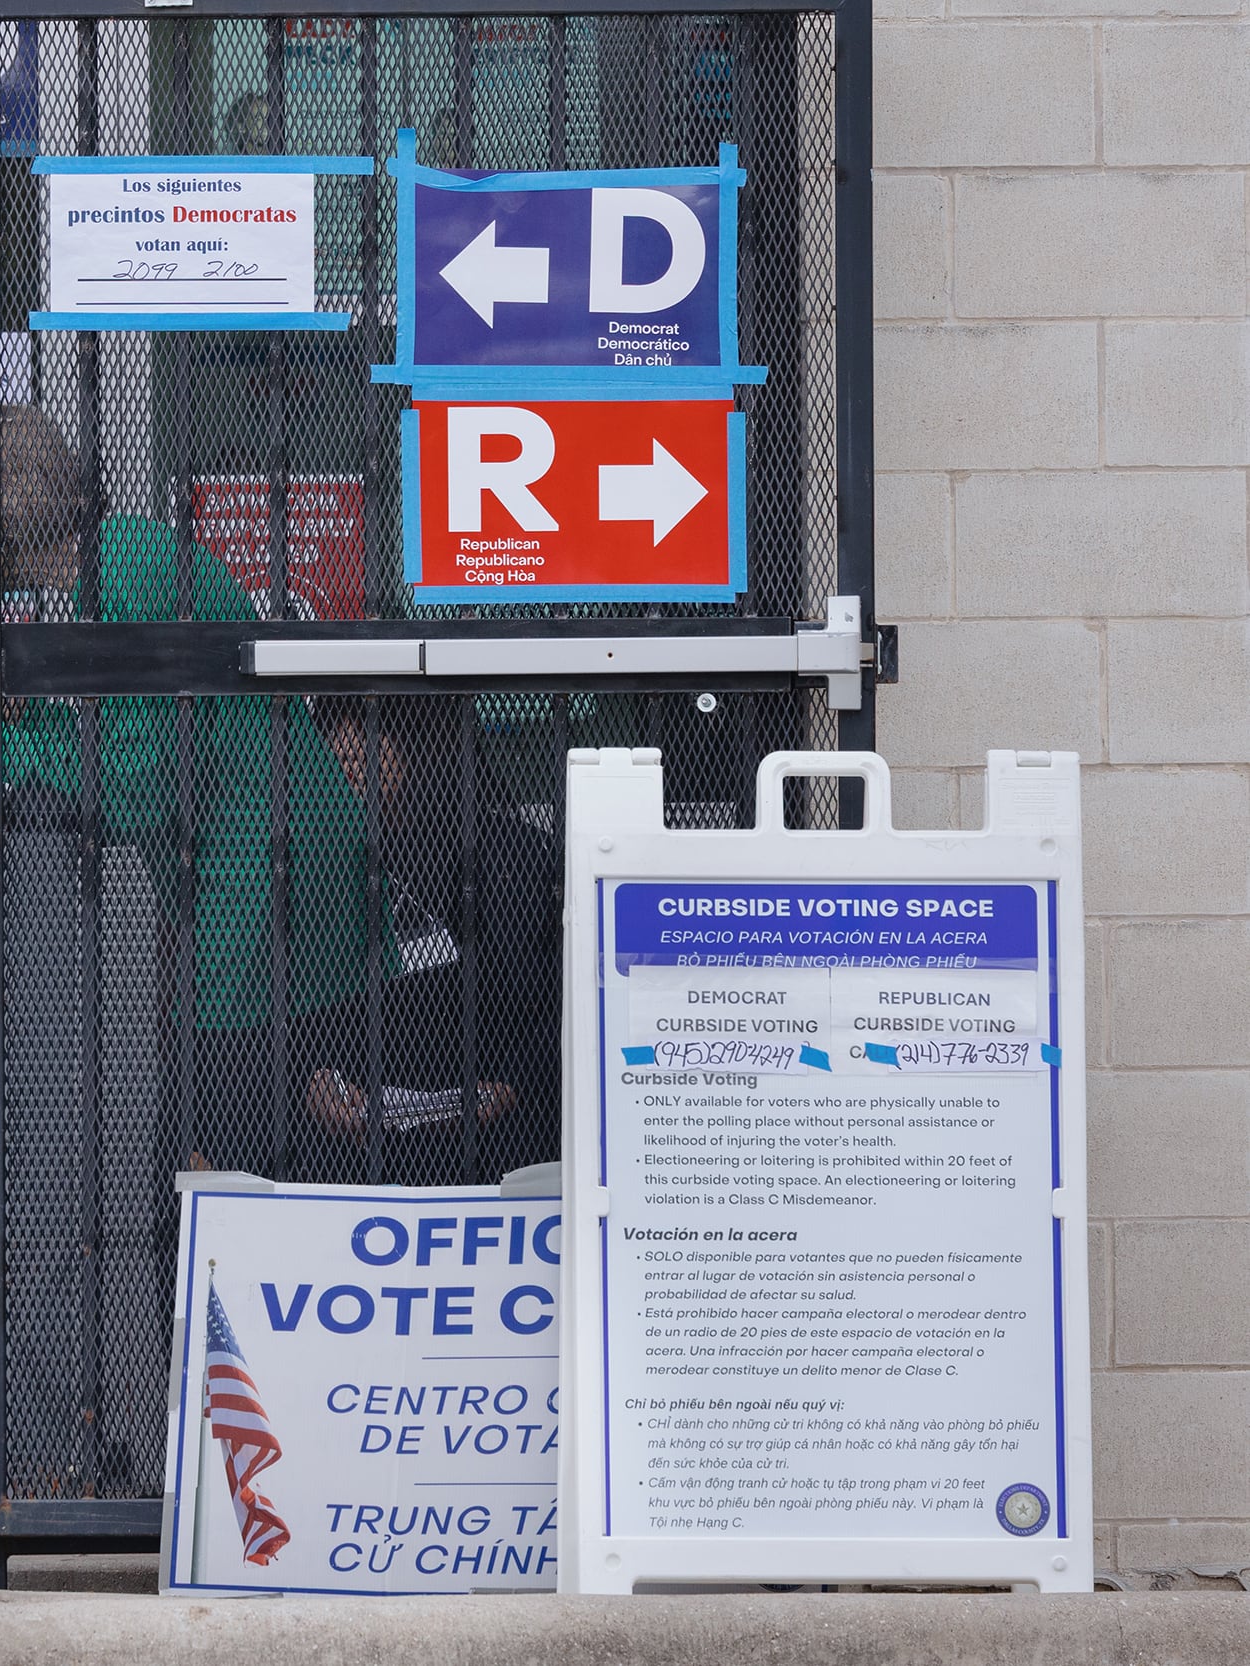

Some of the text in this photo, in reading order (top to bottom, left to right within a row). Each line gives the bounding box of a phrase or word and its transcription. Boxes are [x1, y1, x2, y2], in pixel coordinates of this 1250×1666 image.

[123, 178, 242, 196] Los siguientes
[68, 206, 297, 227] precintos Democratas
[135, 237, 228, 254] votan aquí:
[588, 188, 706, 313] D
[113, 260, 259, 281] 2099 2100
[609, 321, 680, 335] Democrat
[598, 337, 689, 351] Democrático
[615, 352, 672, 368] Dân chủ
[447, 406, 559, 533] R
[461, 537, 540, 555] Republican
[457, 555, 545, 571] Republicano
[466, 569, 536, 586] Cộng Hòa
[658, 898, 994, 917] CURBSIDE VOTING SPACE
[660, 929, 987, 944] ESPACIO PARA VOTACIÓN EN LA ACERA
[688, 991, 787, 1005] DEMOCRAT
[879, 991, 990, 1006] REPUBLICAN
[656, 1018, 818, 1033] CURBSIDE VOTING
[854, 1017, 1015, 1034] CURBSIDE VOTING
[621, 1071, 758, 1089] Curbside Voting
[643, 1095, 1000, 1111] ONLY available for voters who are physically unable to
[644, 1193, 876, 1206] violation is a Class C Misdemeanor.
[623, 1227, 797, 1241] Votación en la acera
[260, 1283, 556, 1336] VOTE C
[327, 1384, 529, 1416] CENTRO
[360, 1425, 426, 1455] DE
[327, 1504, 492, 1536] TRUNG
